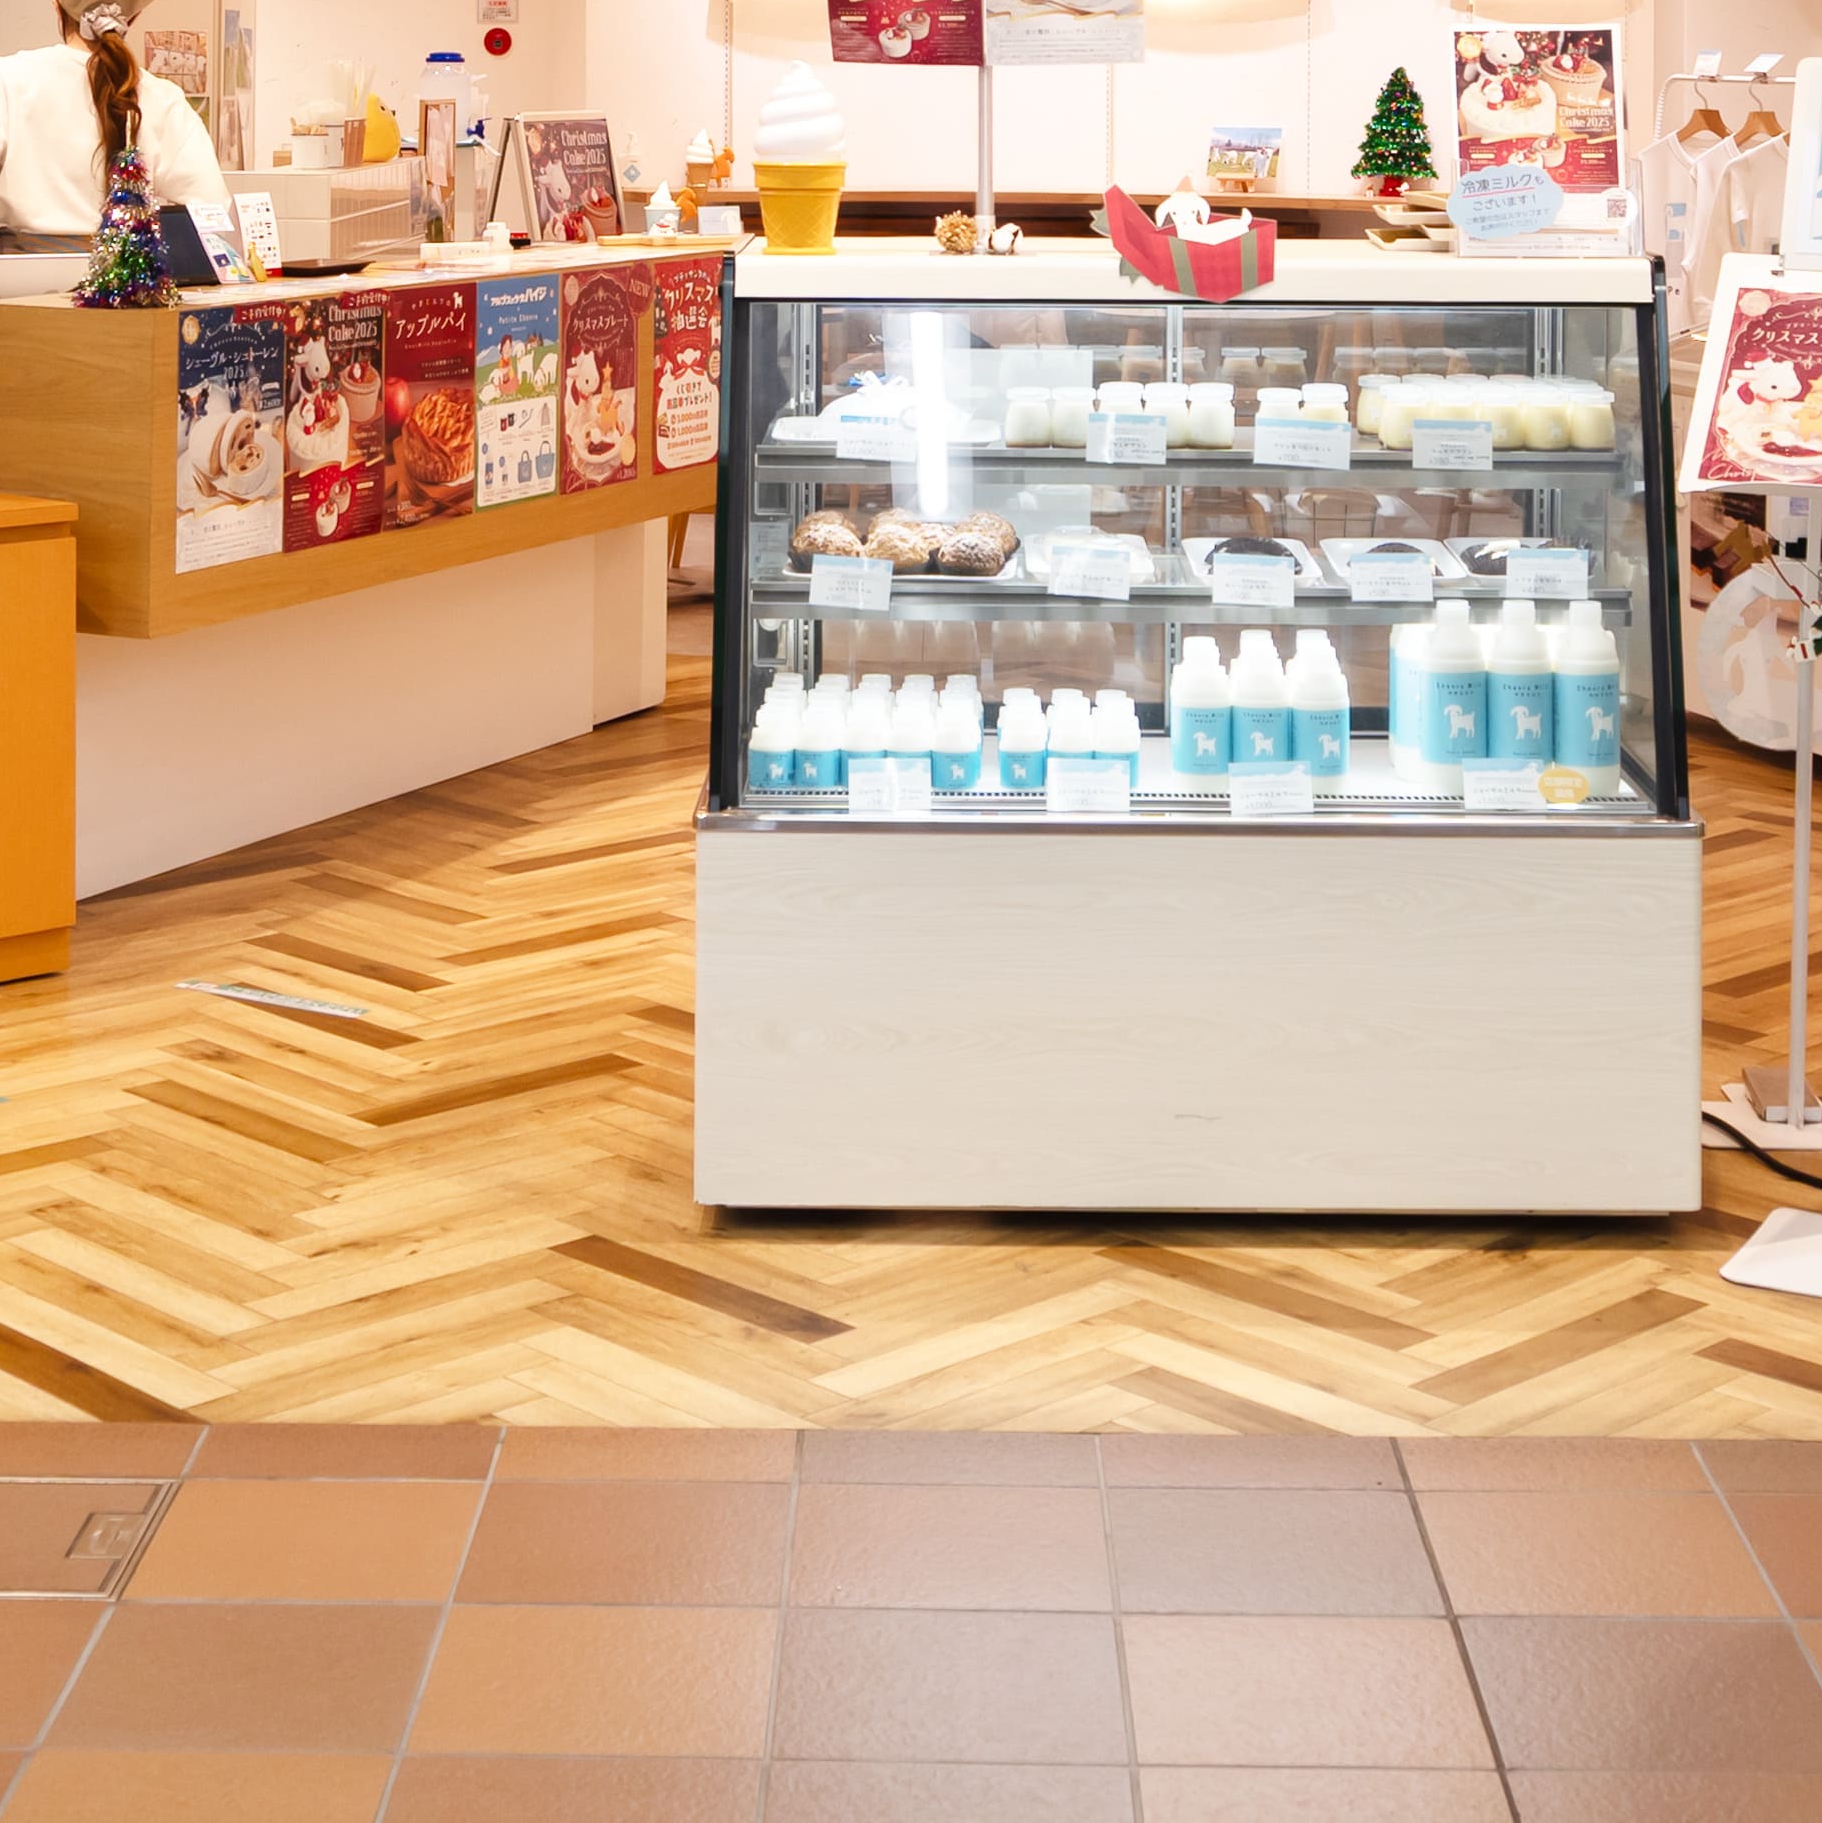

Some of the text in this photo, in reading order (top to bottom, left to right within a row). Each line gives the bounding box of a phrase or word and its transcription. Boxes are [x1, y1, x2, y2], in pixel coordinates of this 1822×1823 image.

[561, 130, 607, 147] Christmas
[586, 148, 606, 165] 2025
[629, 281, 651, 297] NEW
[664, 282, 714, 310] クリスマス
[354, 321, 378, 340] 2025
[395, 310, 467, 340] アップルパイ
